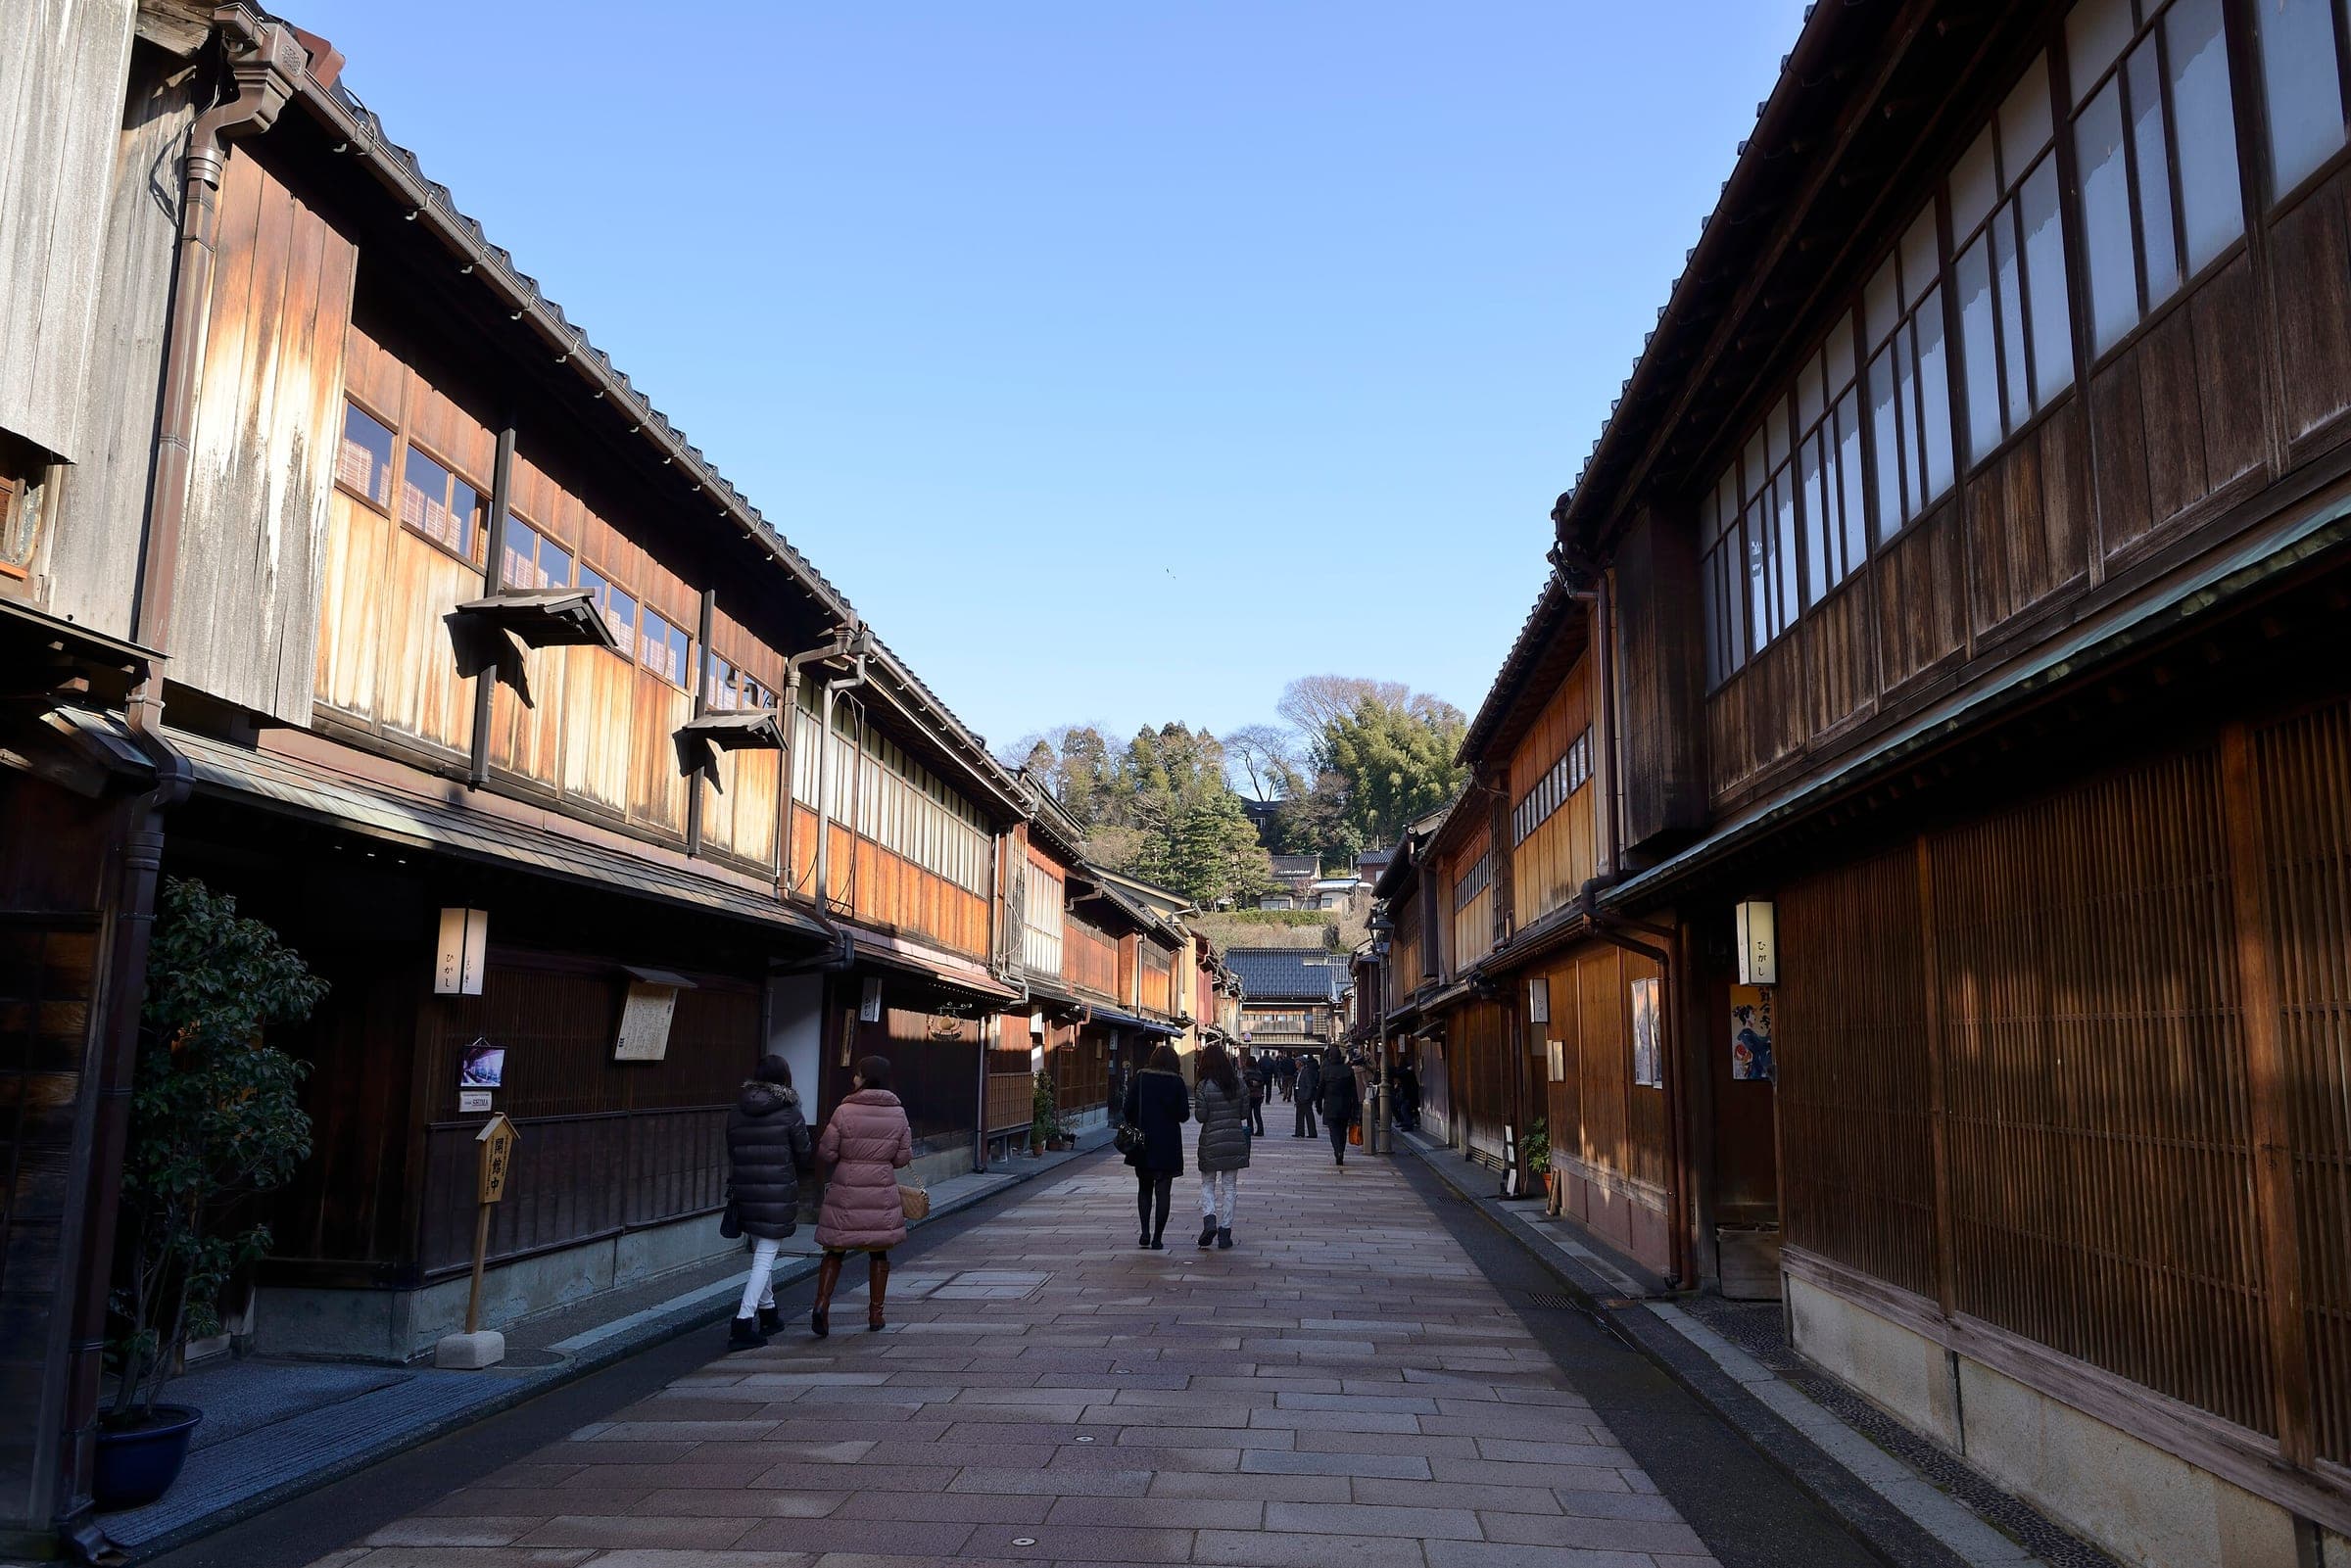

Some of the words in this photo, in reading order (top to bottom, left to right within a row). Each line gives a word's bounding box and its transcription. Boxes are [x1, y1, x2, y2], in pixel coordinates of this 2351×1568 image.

[444, 953, 455, 988] ひがし
[1756, 940, 1767, 976] ひがし
[491, 1137, 504, 1194] 開館中
